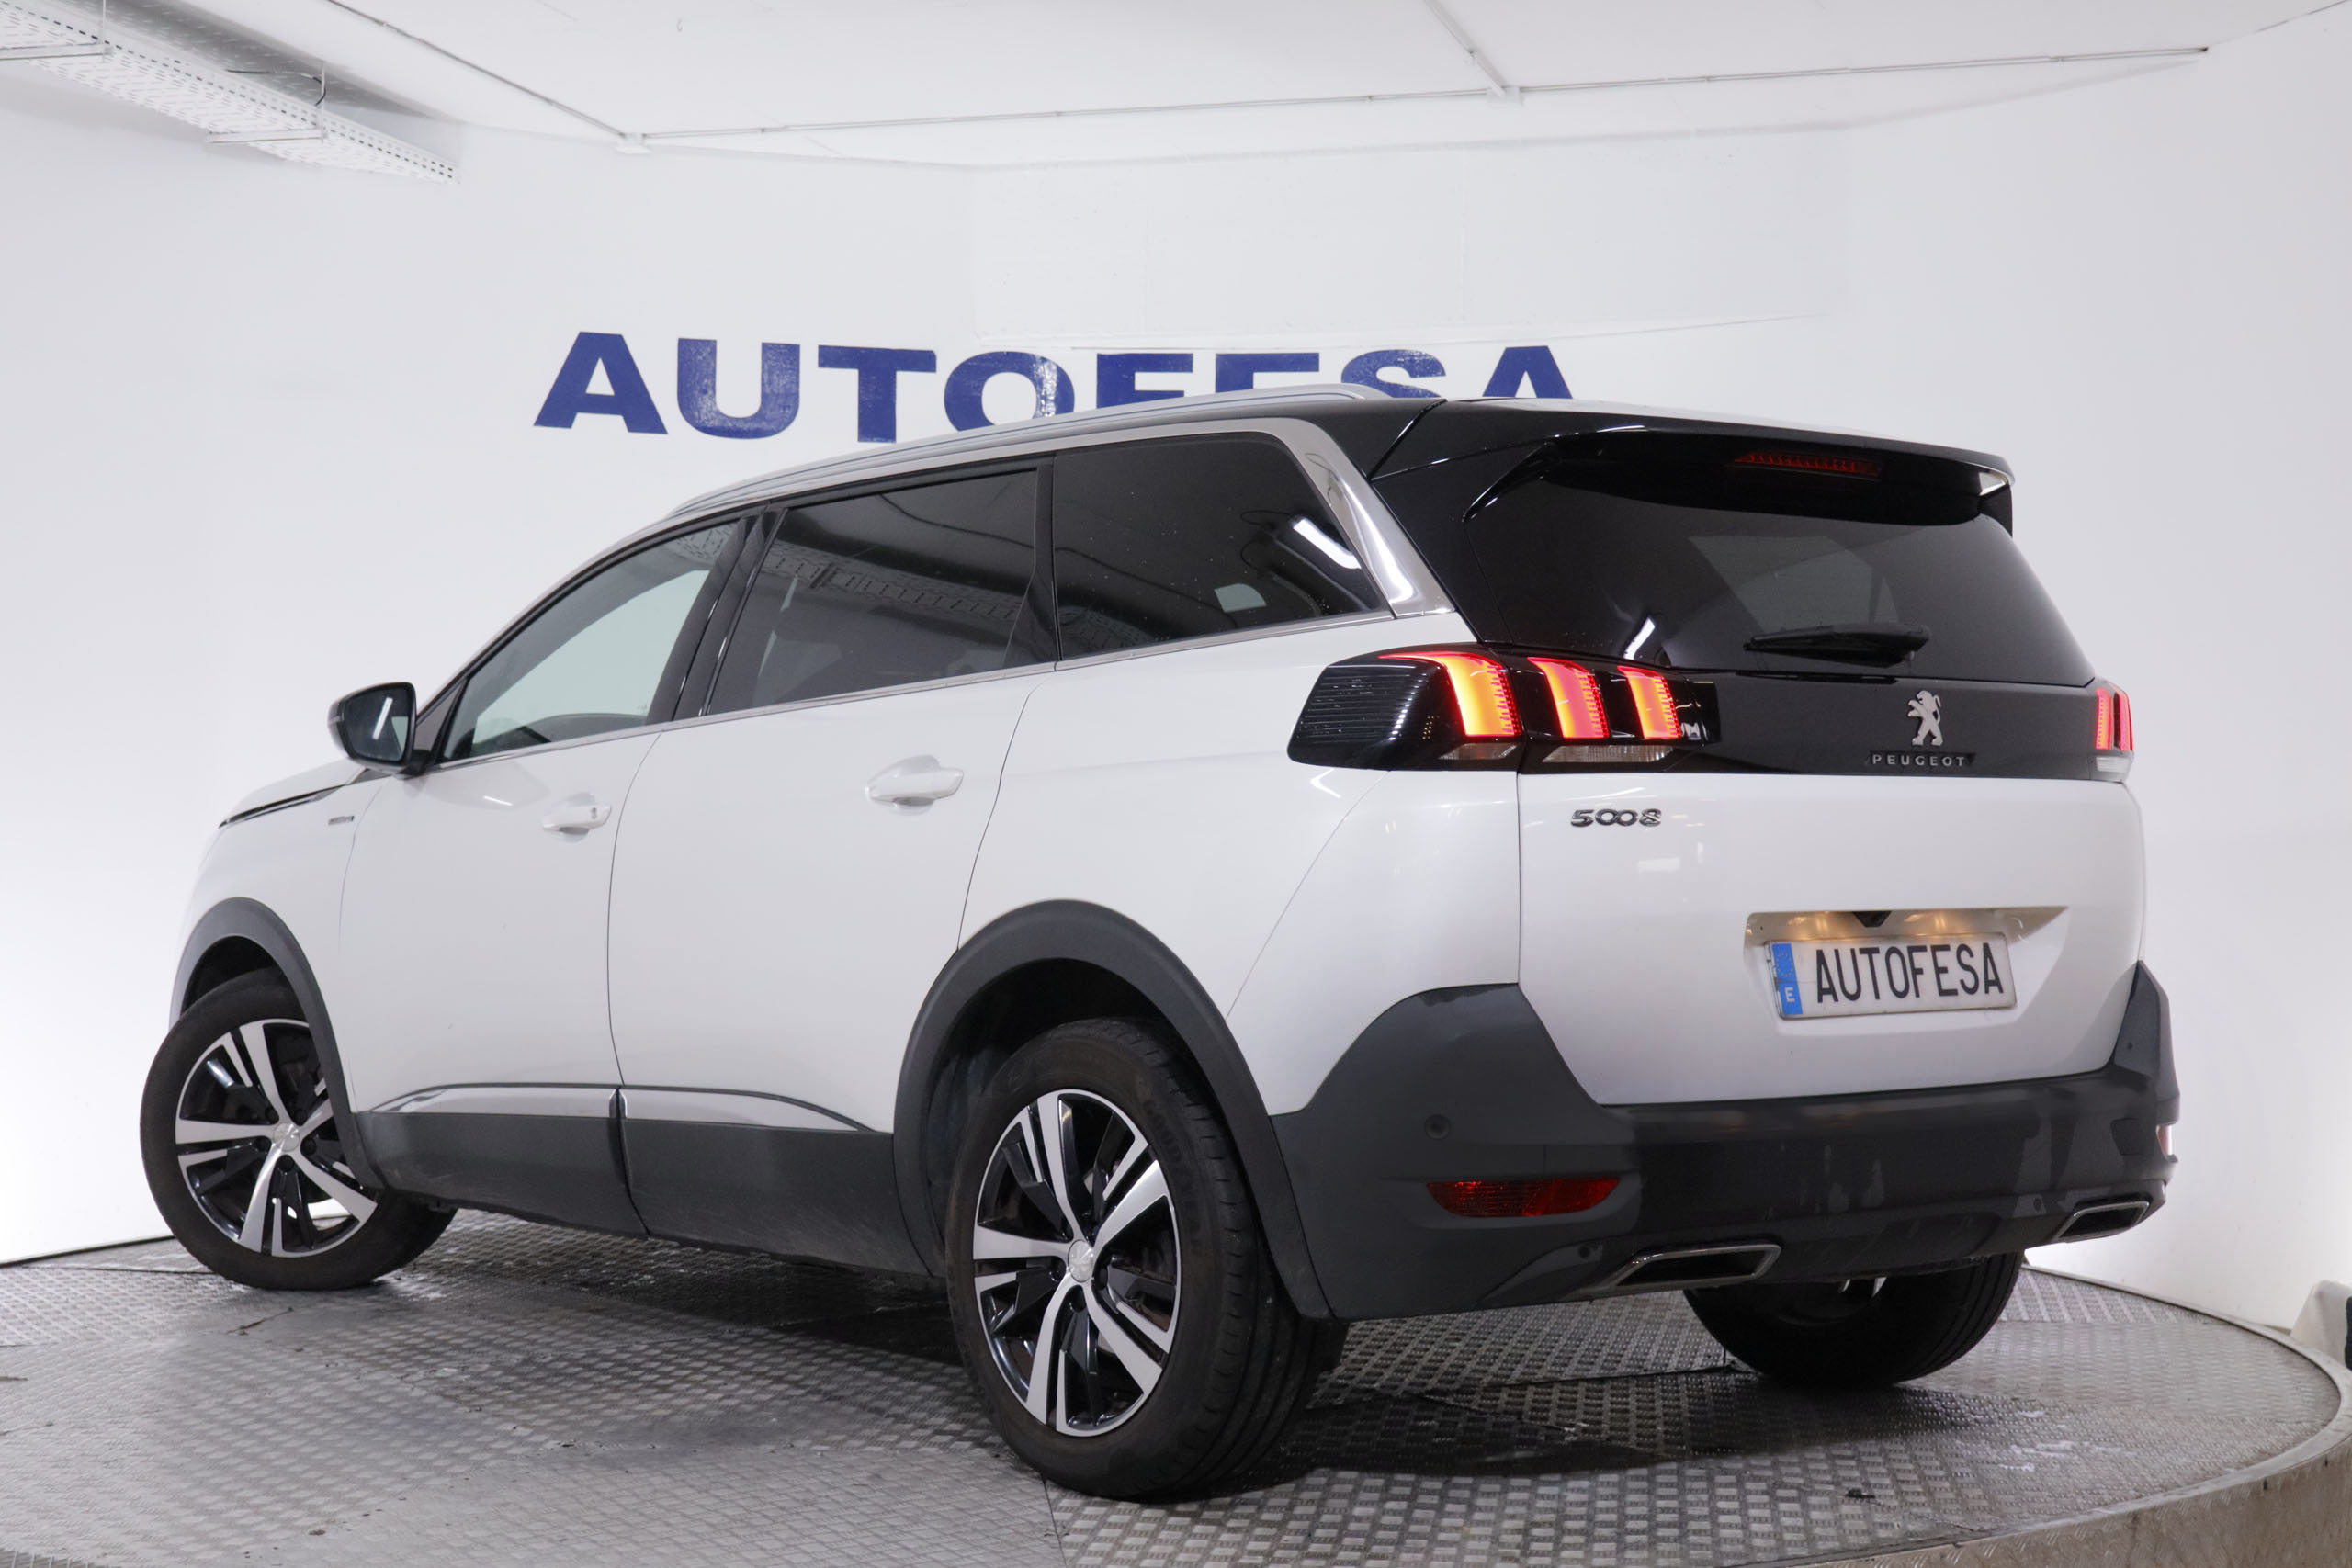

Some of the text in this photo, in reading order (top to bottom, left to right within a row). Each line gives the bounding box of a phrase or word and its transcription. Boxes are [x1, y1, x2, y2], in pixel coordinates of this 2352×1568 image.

[1871, 754, 1965, 767] PEUGEOT
[1570, 808, 1662, 828] 5008
[1784, 942, 2004, 1003] E AUTOFESA
